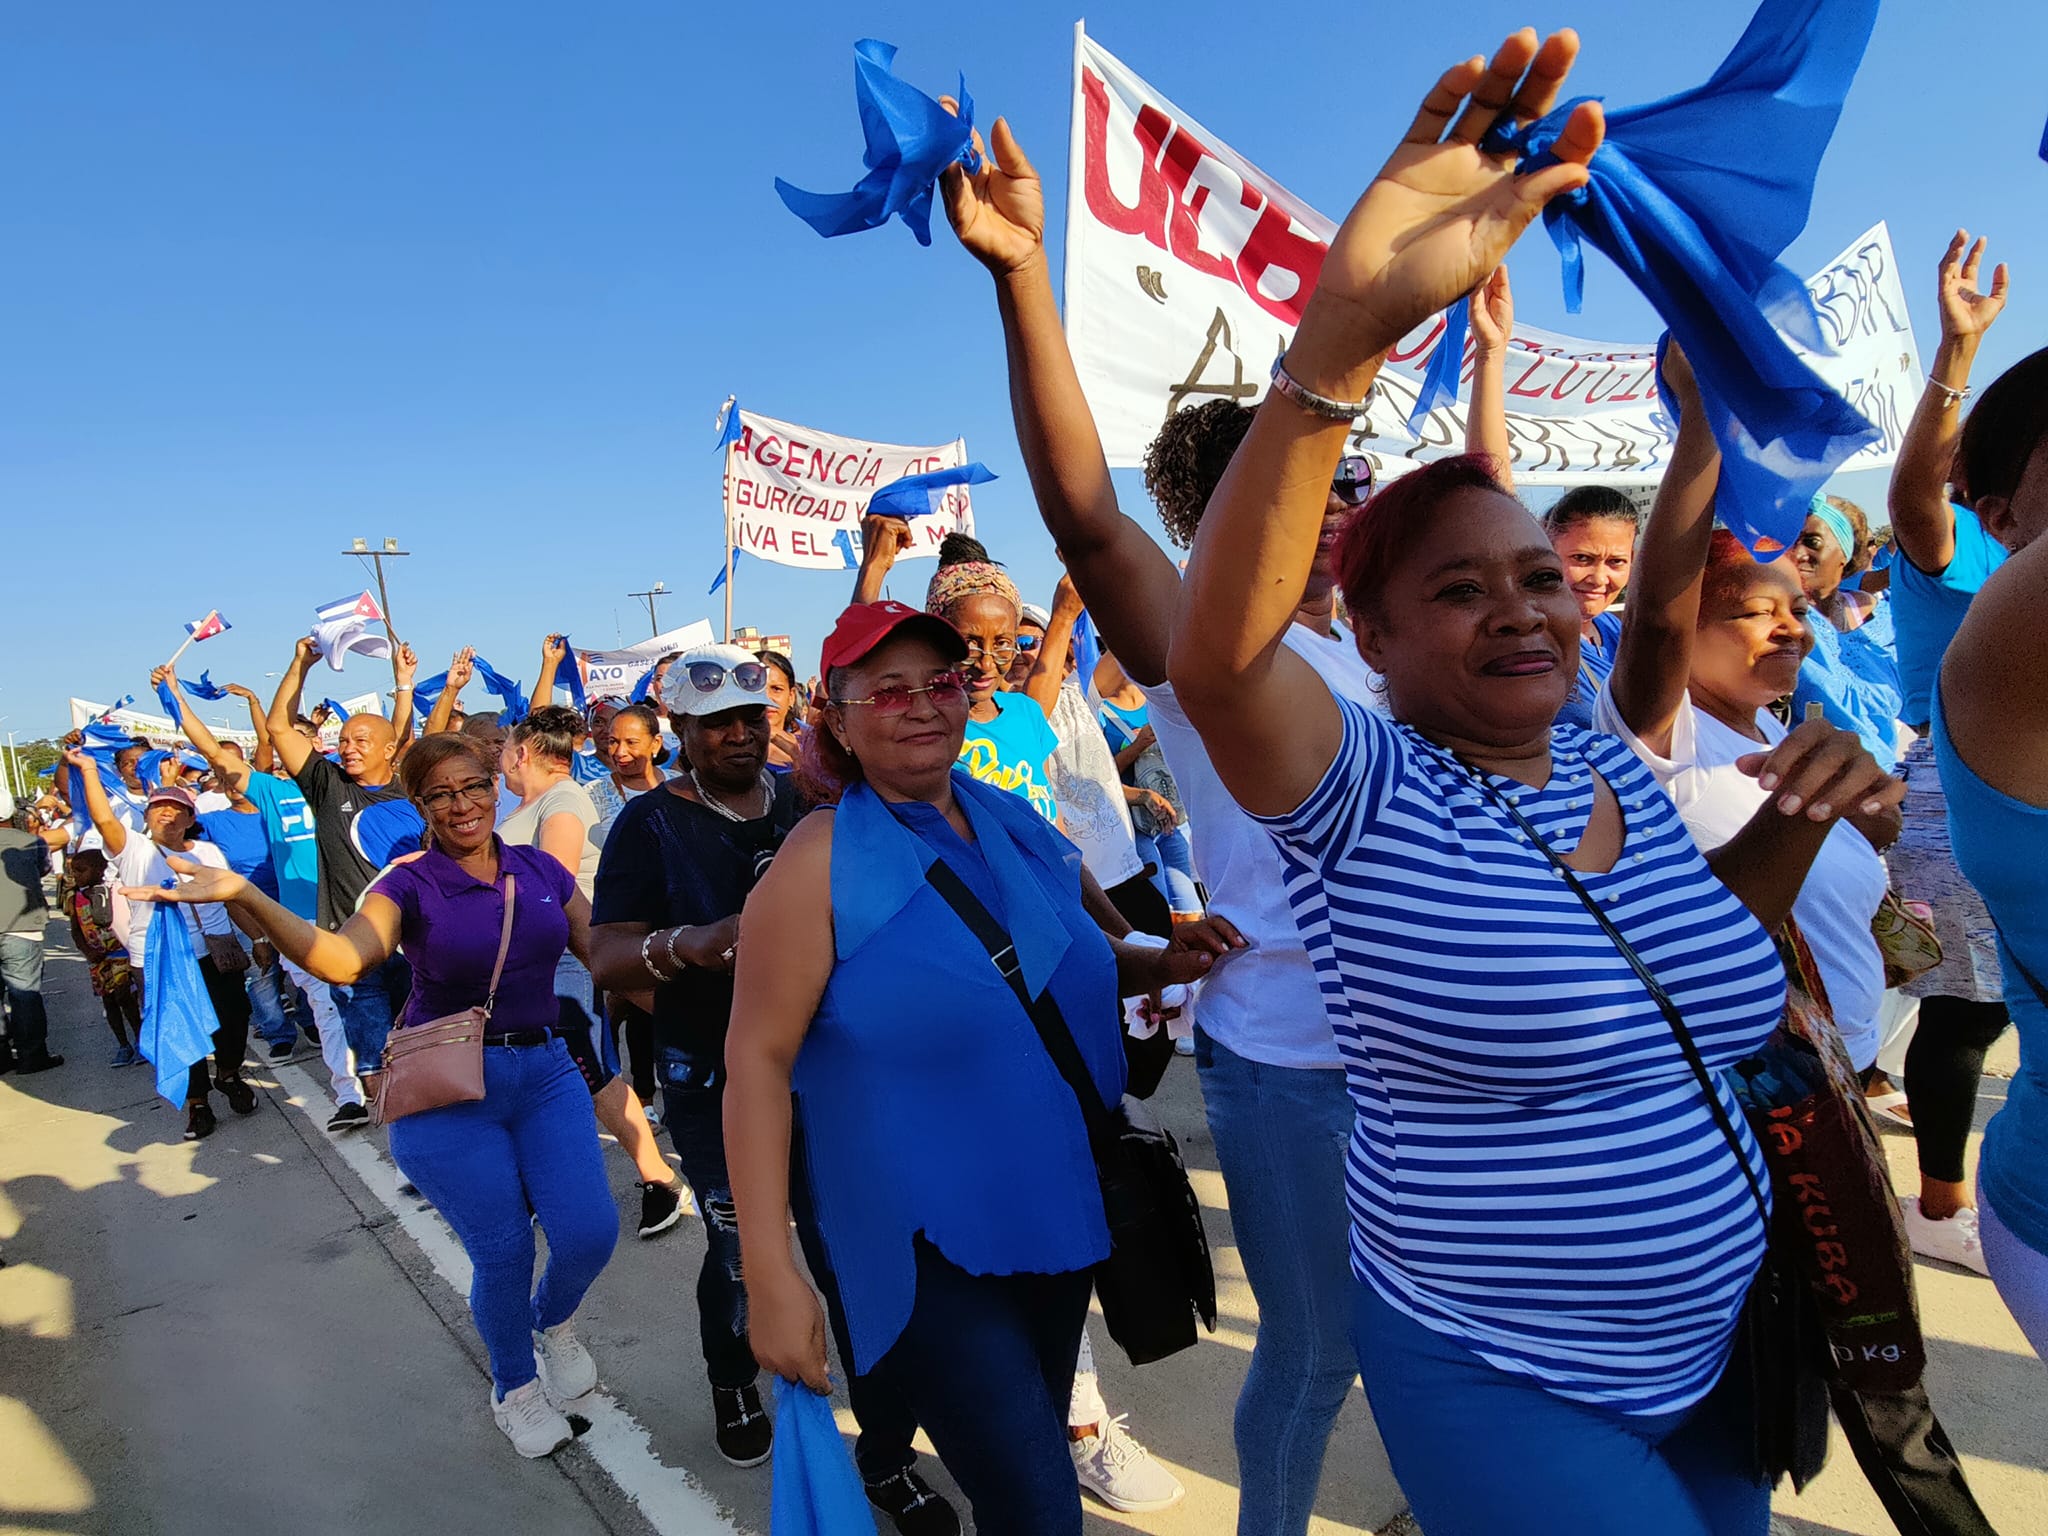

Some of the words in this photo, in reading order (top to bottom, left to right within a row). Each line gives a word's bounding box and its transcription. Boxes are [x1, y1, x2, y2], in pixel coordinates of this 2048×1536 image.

[723, 474, 847, 523] GURIDAD
[739, 512, 779, 553] IVA
[791, 530, 828, 557] EL
[589, 666, 623, 682] AYO
